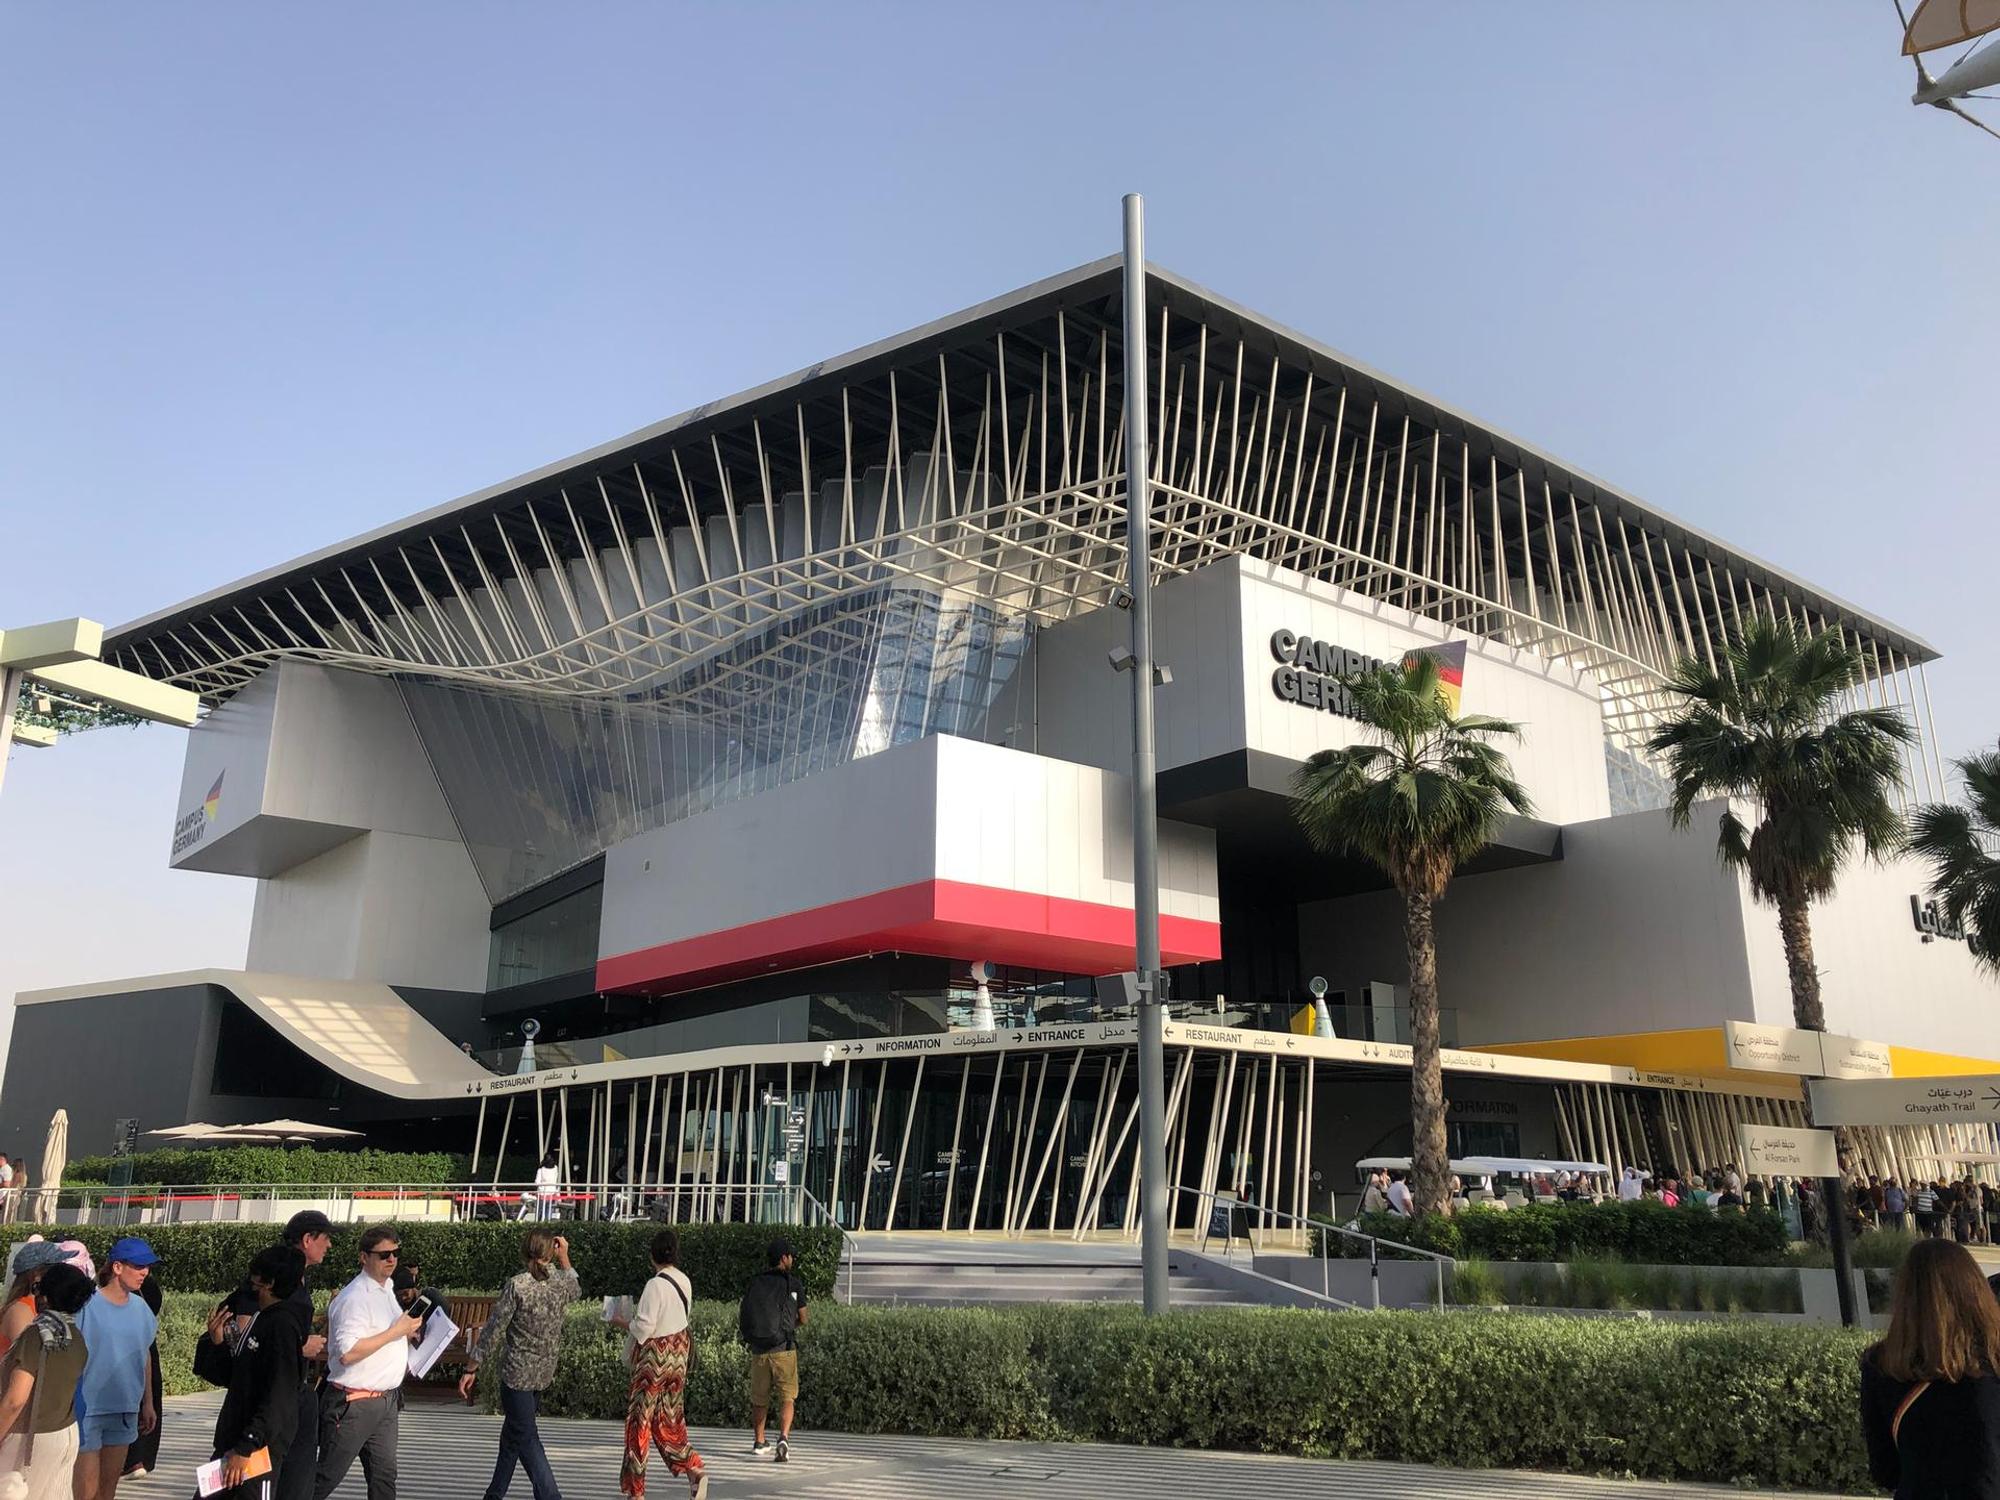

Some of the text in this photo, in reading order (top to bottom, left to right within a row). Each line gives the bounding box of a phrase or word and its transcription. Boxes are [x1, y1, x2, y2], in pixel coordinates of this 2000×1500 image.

[1272, 665, 1368, 723] GERM
[175, 805, 205, 837] CAMPUS
[172, 822, 206, 856] GERMANY
[1028, 1029, 1085, 1042] ENTRANCE
[1099, 1025, 1125, 1040] مدخل
[1186, 1028, 1242, 1044] RESTAURANT
[876, 1038, 941, 1052] INFORMATION
[952, 1032, 997, 1047] المعلومات
[1253, 1036, 1276, 1048] مطعم
[1389, 1049, 1415, 1060] AUDITO
[1748, 1050, 1800, 1063] Opportunity District
[490, 1076, 536, 1090] RESTAURANT
[544, 1071, 563, 1084] مطعم
[1646, 1074, 1676, 1085] ENTRANCE
[1953, 1088, 1973, 1098] درب
[1453, 1100, 1519, 1116] ORMATION
[1905, 1102, 1976, 1114] Ghayath Trail
[1771, 1154, 1788, 1163] Forsan
[1788, 1154, 1800, 1163] Park
